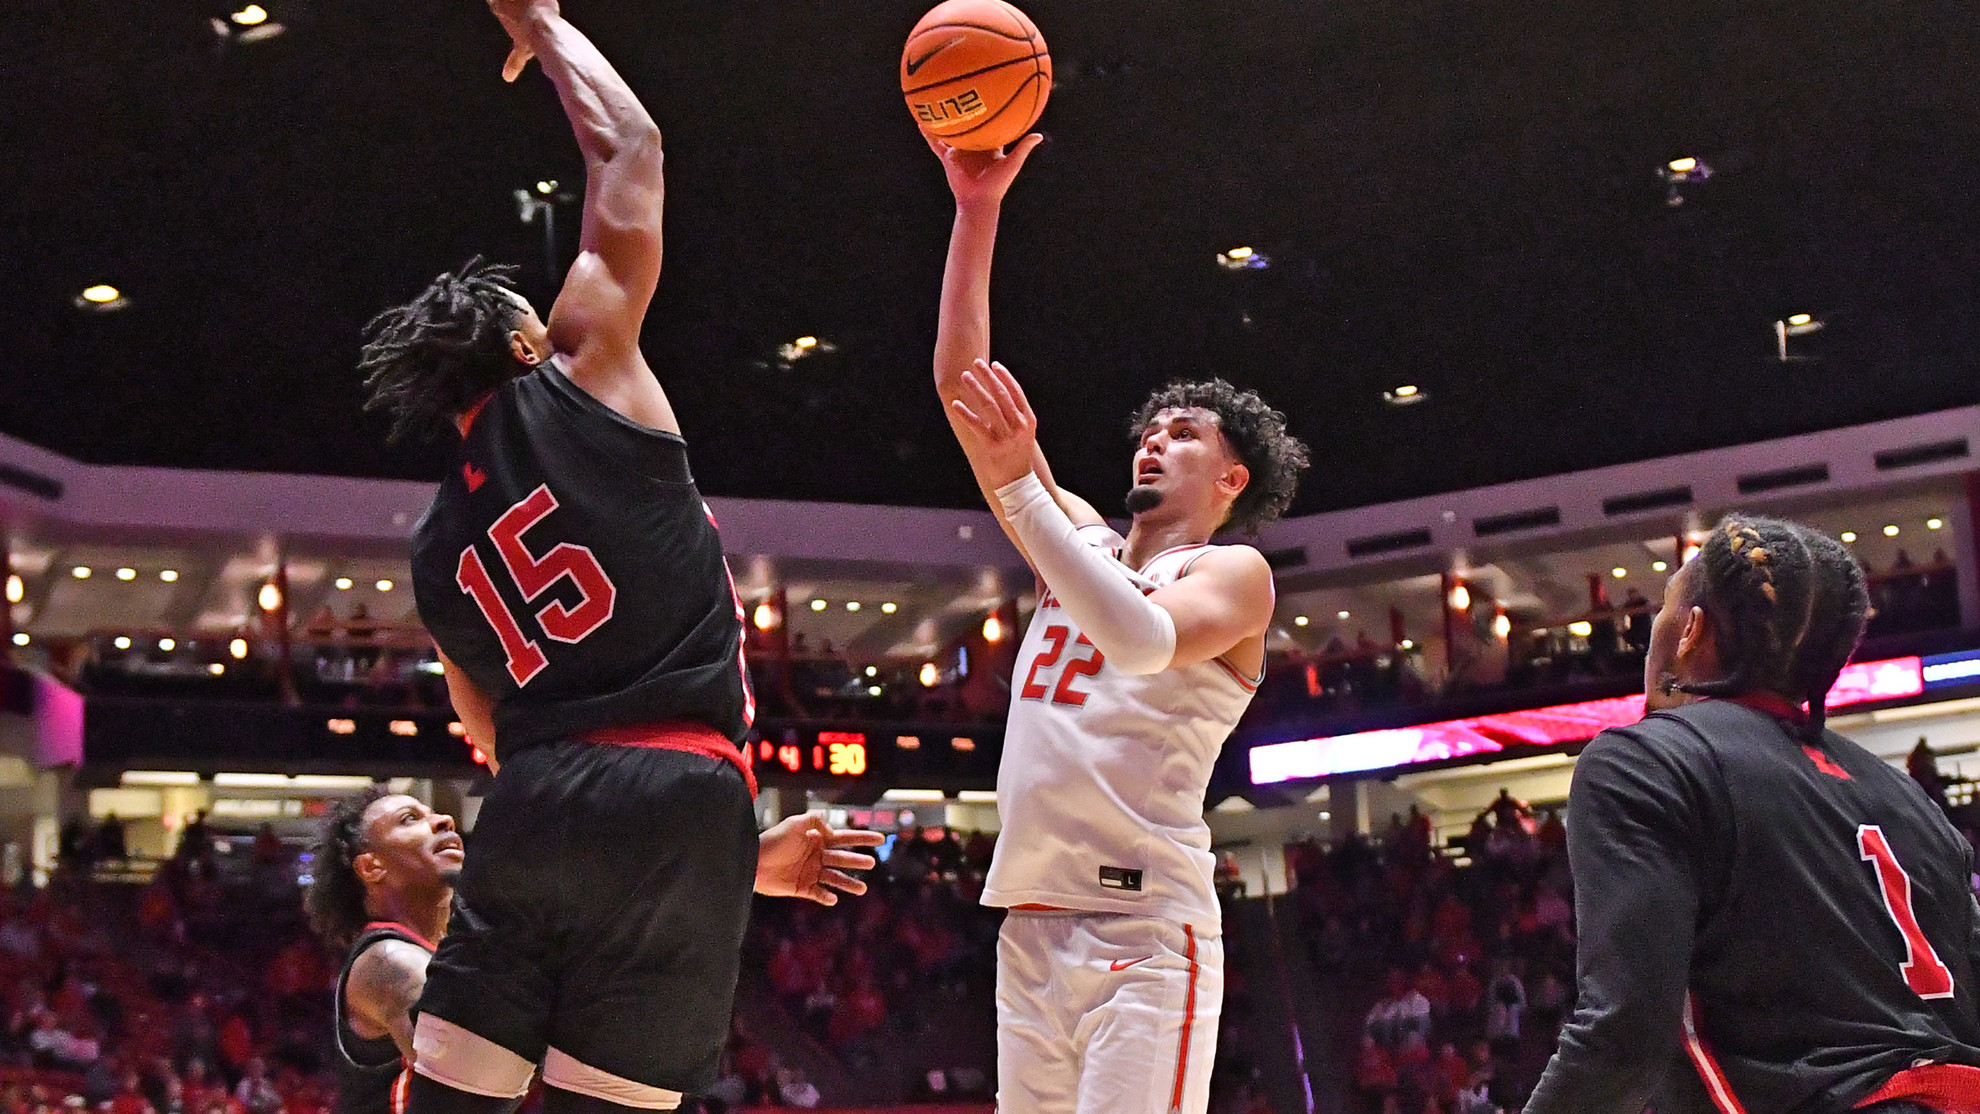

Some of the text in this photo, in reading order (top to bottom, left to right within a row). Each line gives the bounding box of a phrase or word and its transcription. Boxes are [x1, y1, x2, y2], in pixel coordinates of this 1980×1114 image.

[914, 89, 983, 122] ELITE
[456, 483, 616, 688] 15
[1020, 625, 1106, 708] 22
[829, 743, 866, 775] 30
[1128, 875, 1134, 885] L
[1857, 824, 1954, 1000] 1
